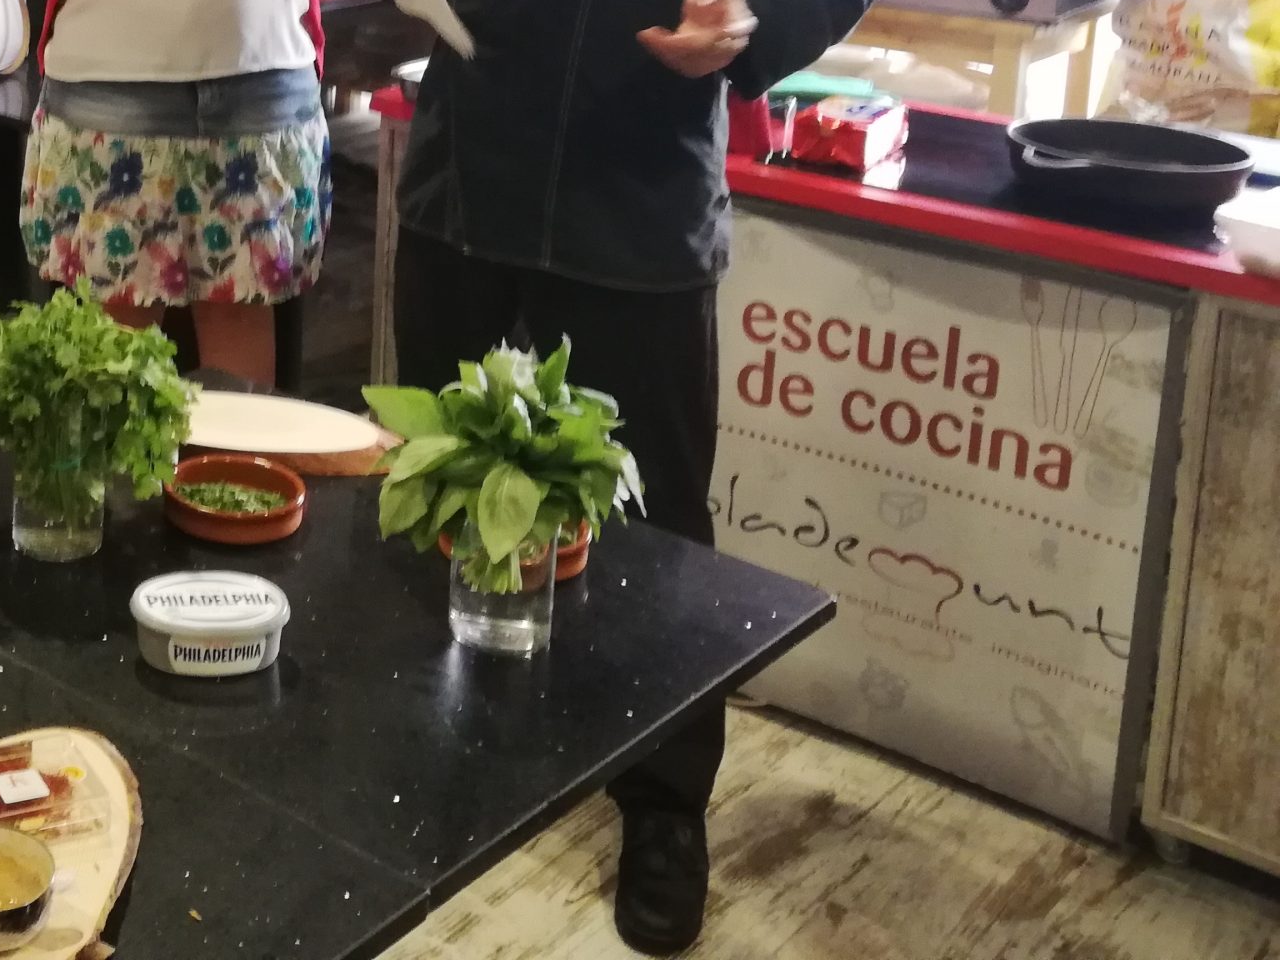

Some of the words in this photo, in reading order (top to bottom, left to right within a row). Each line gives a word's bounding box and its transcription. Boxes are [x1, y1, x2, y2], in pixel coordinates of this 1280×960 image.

[741, 300, 1001, 401] escuela
[736, 348, 816, 418] de
[840, 388, 1074, 492] cocina
[145, 592, 276, 609] PHILADELPHIA
[173, 643, 261, 664] PHILADELPHIA
